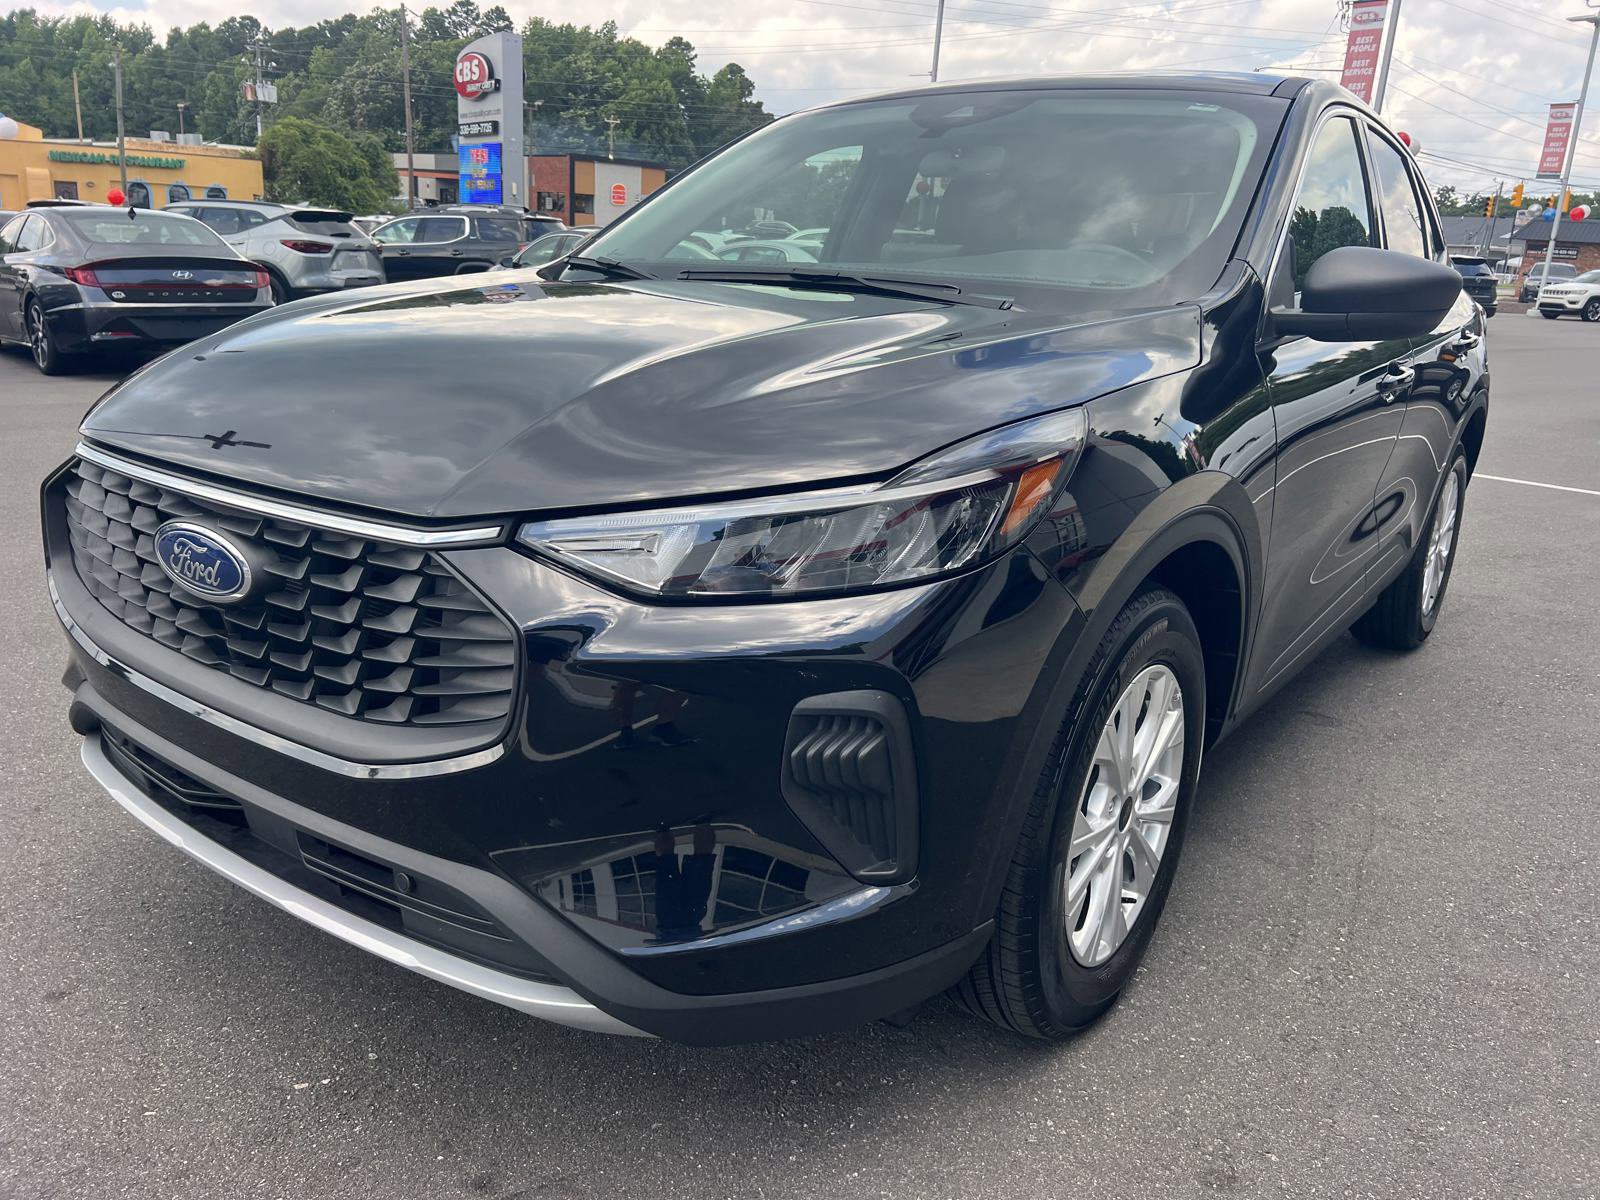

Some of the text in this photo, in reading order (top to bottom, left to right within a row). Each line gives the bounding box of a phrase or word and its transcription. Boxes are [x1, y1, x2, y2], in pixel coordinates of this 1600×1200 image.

[1350, 44, 1376, 52] PEOPLE
[456, 58, 480, 83] CBS
[170, 537, 221, 586] Ford
